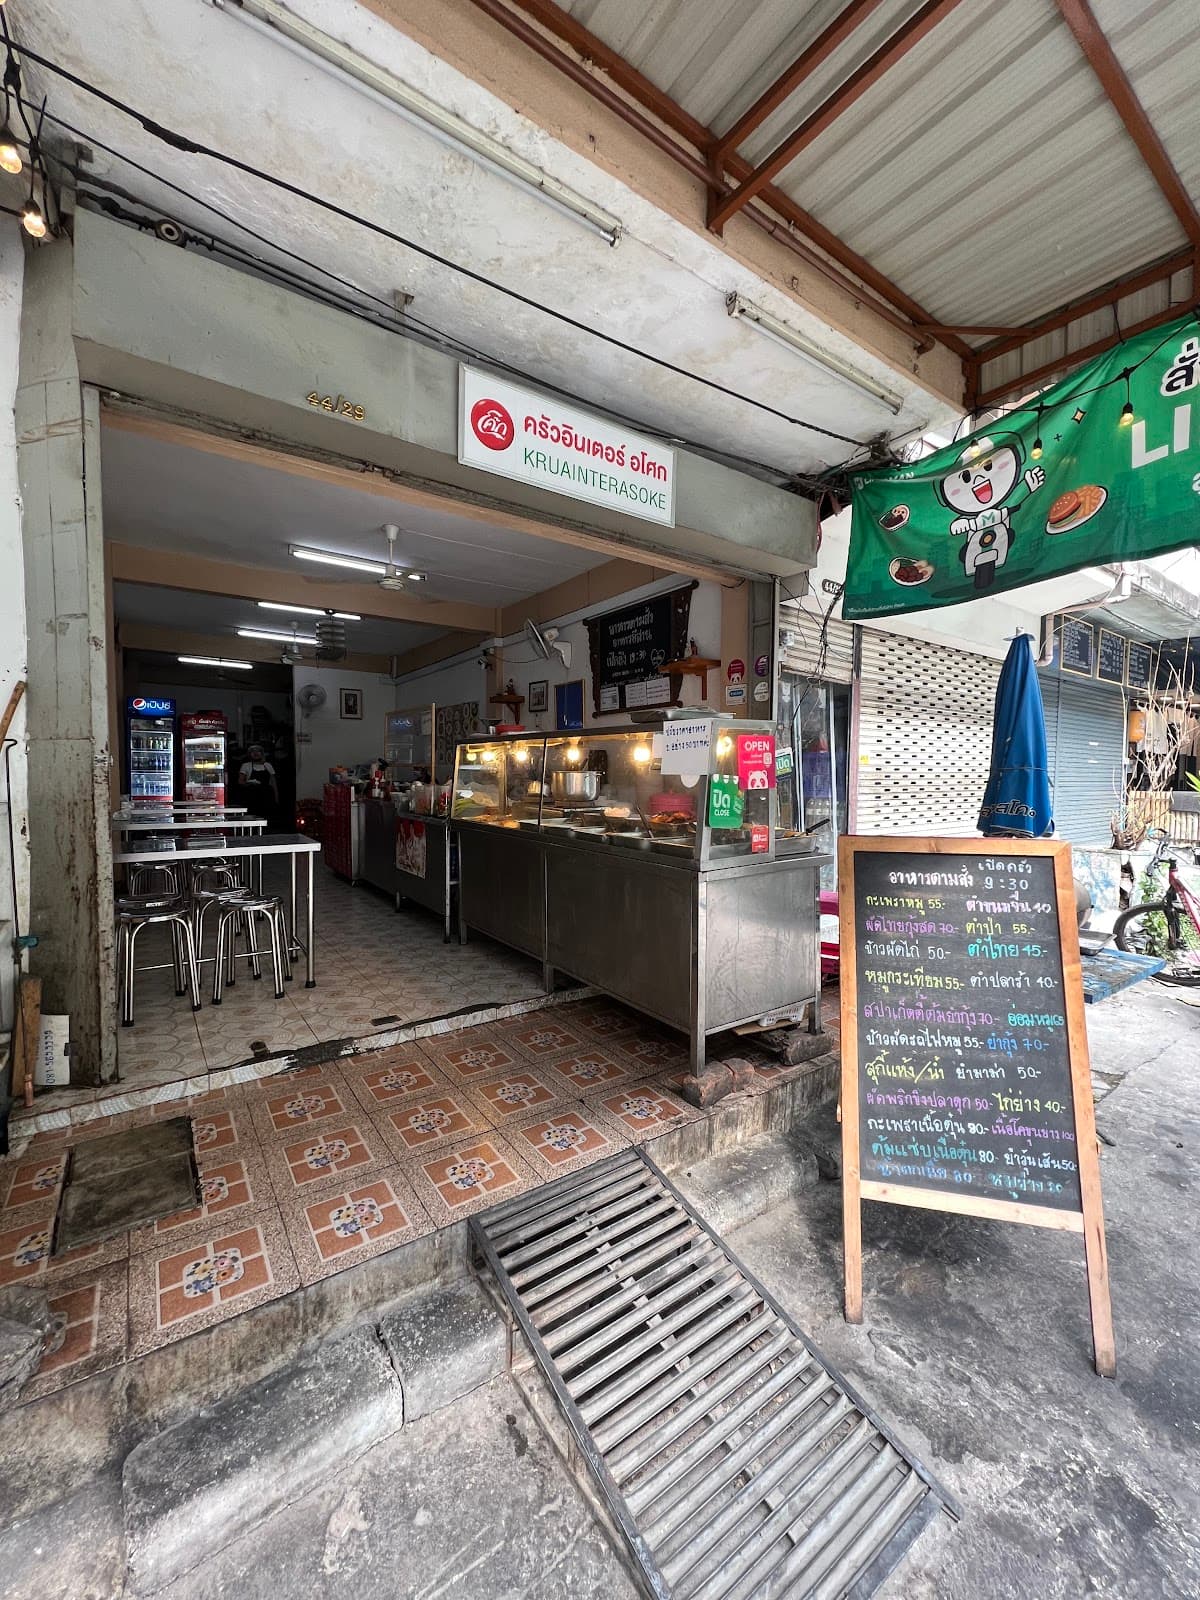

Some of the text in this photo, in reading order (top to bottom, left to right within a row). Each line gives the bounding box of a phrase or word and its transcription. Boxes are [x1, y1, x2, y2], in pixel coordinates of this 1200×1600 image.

[524, 414, 668, 482] ครัวอินเตอร์ อโศก
[523, 447, 667, 511] KRUAINTERASOKE
[744, 741, 770, 752] OPEN
[713, 789, 731, 809] ปิด
[714, 809, 730, 817] CLOSE
[889, 864, 974, 888] อาหารตามสั่ง
[865, 914, 937, 939] ผัดไทยกุ้งสด
[966, 916, 1002, 936] ตำป่า
[864, 939, 921, 959] ข้าวผัดไก่
[967, 934, 1020, 959] ตำไทย
[864, 966, 944, 993] หมูกระเทียม
[970, 970, 1031, 989] ตำปลาร้า
[866, 1026, 962, 1056] ข้าวผัดรถไฟหมู
[987, 1031, 1018, 1058] ยำกุ้ง
[956, 1062, 1006, 1080] ยำมาม่า
[992, 1088, 1041, 1113] ไก่ย่าง
[1003, 1147, 1060, 1176] ยำวุ้นเส้น
